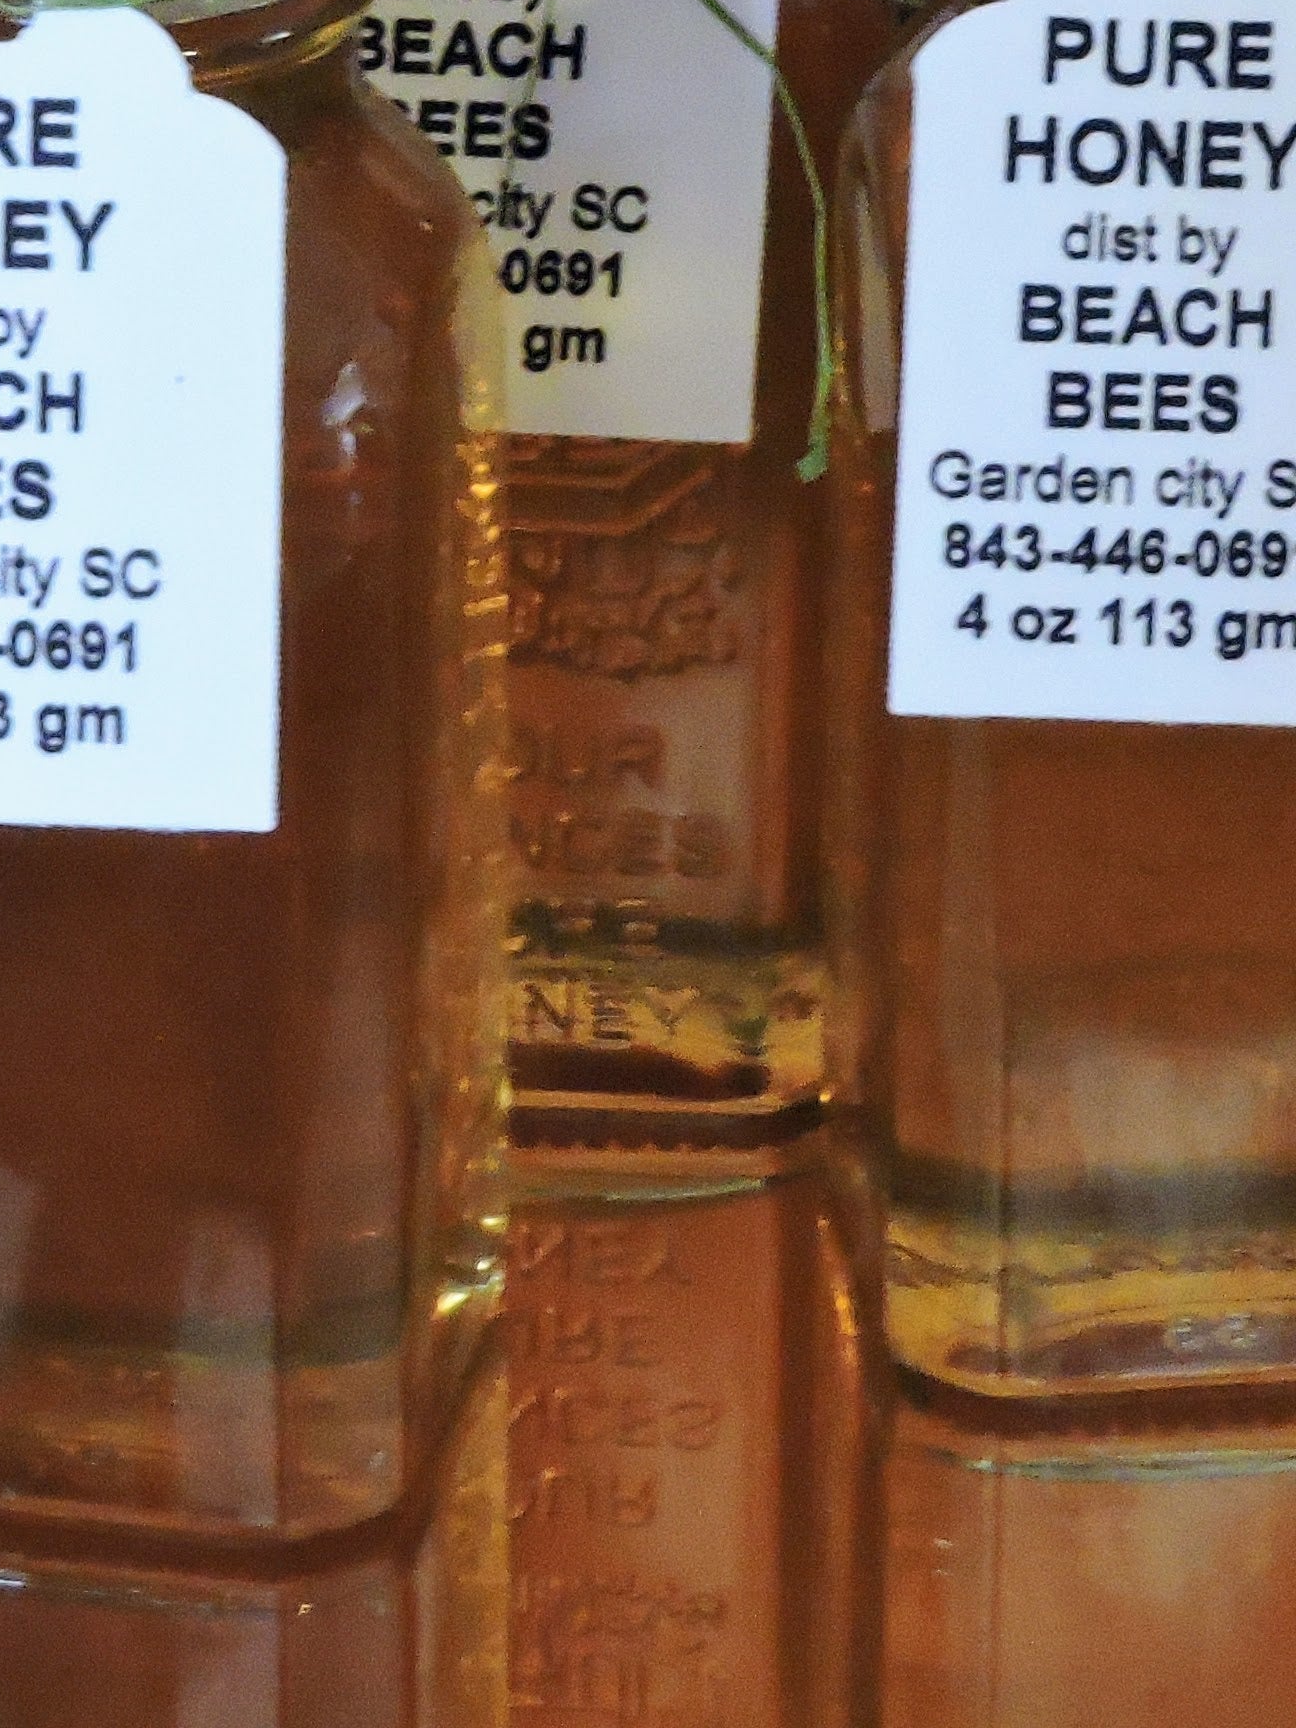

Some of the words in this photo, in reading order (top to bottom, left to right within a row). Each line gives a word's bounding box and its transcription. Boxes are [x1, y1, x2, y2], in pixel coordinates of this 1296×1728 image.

[1046, 17, 1274, 91] PURE
[393, 100, 553, 161] EES
[1006, 116, 1296, 192] HONEY
[570, 183, 650, 233] SC
[1063, 214, 1159, 264] dist
[1179, 217, 1238, 279] by
[523, 323, 608, 371] gm
[1020, 284, 1274, 350] BEACH
[1048, 372, 1240, 436] BEES
[930, 450, 1134, 506] Garden
[1156, 459, 1246, 521] city
[1266, 459, 1296, 511] S
[83, 548, 160, 601] SC
[945, 523, 1291, 580] 843-446-069
[957, 594, 989, 640] 4
[1012, 606, 1078, 646] oz
[1101, 598, 1195, 649] 113
[1217, 611, 1296, 662] gm
[38, 705, 125, 755] gm
